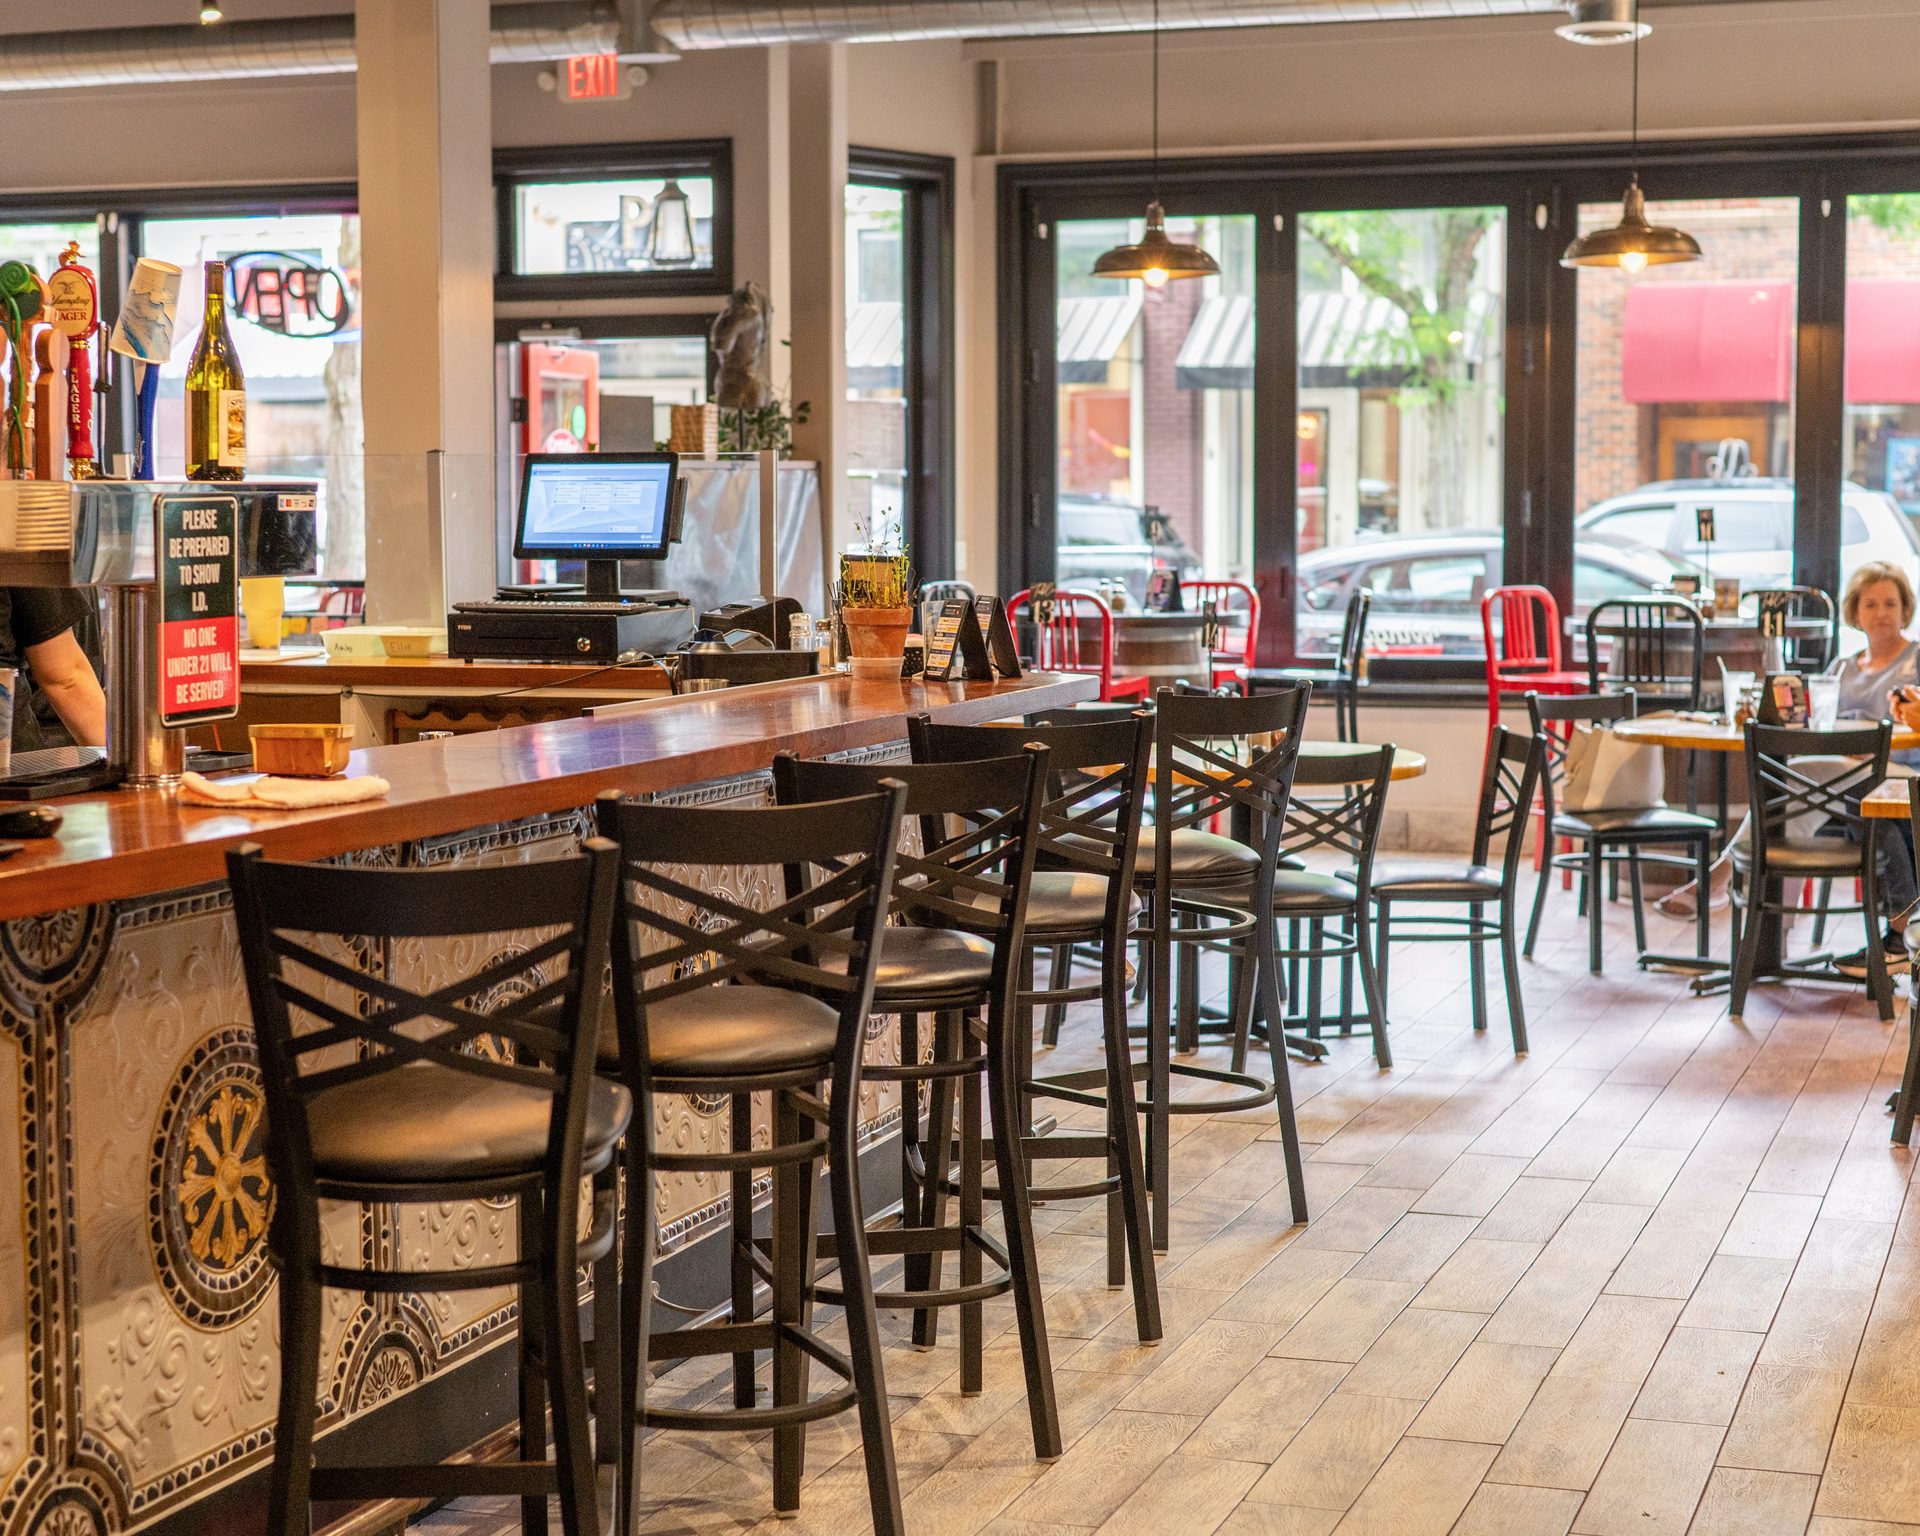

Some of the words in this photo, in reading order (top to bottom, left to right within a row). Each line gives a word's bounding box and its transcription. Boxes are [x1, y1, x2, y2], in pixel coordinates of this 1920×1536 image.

[568, 54, 617, 98] EXIT
[58, 311, 87, 321] AGER
[70, 373, 81, 424] LAGER
[182, 509, 218, 530] PLEASE
[169, 538, 182, 559] BE
[183, 536, 229, 557] PREPARED
[179, 565, 192, 586] TO
[193, 563, 221, 585] SHOW
[1032, 600, 1056, 624] 13
[183, 628, 198, 649] NO
[198, 626, 217, 647] ONE
[1205, 622, 1219, 649] 14
[167, 655, 199, 678] UNDER
[199, 654, 210, 674] 21
[210, 652, 232, 673] WILL
[176, 683, 189, 704] BE
[189, 679, 224, 702] SERVED
